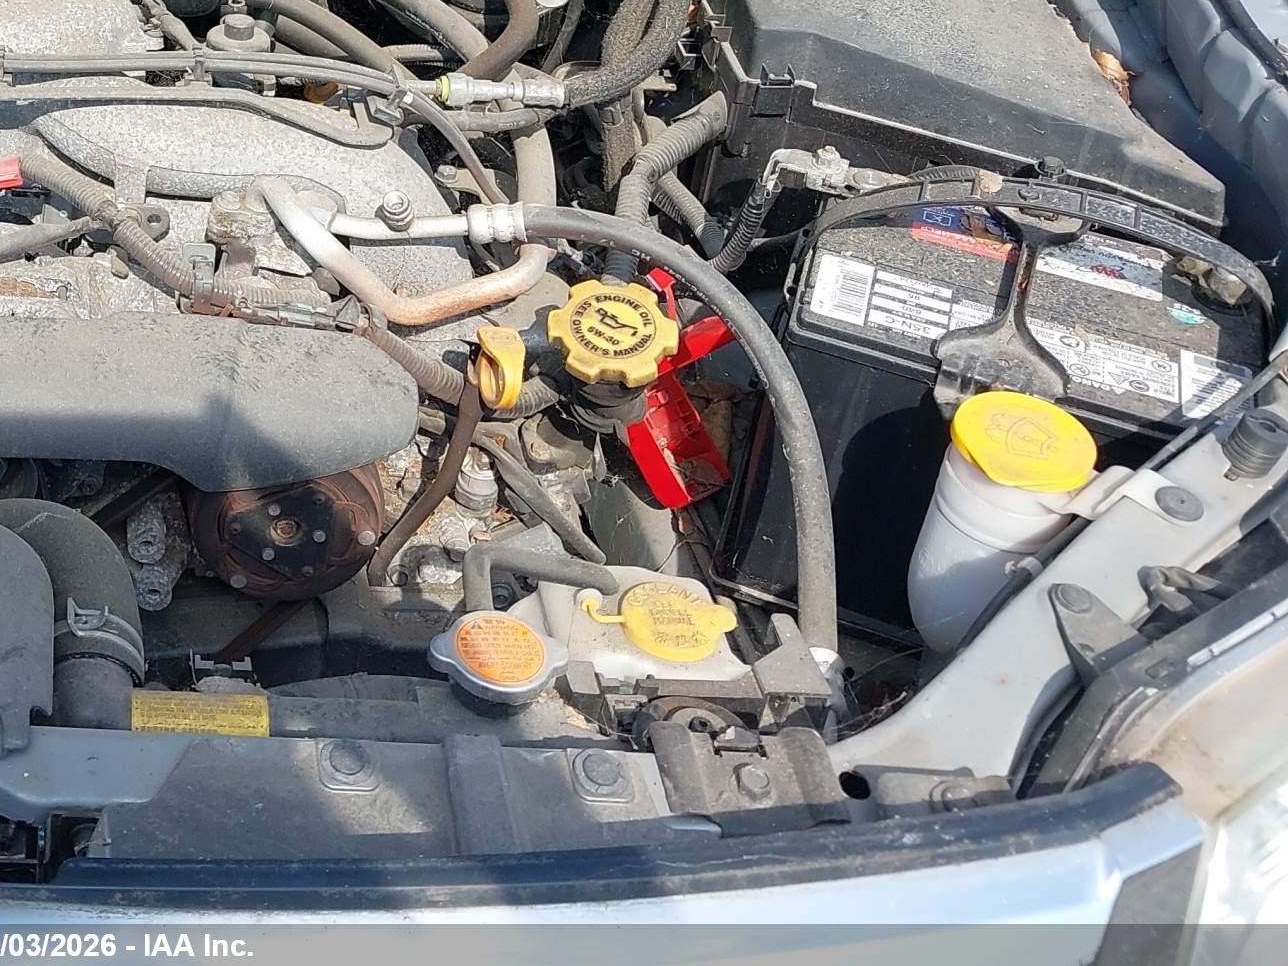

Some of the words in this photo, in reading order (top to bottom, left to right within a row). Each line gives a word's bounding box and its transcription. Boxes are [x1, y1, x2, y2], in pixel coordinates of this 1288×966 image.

[574, 300, 592, 318] SEE
[594, 295, 641, 311] ENGINE
[639, 309, 653, 327] OIL
[572, 319, 610, 356] OWNER'S
[587, 325, 620, 346] 5W-30
[613, 333, 652, 357] MANUAL
